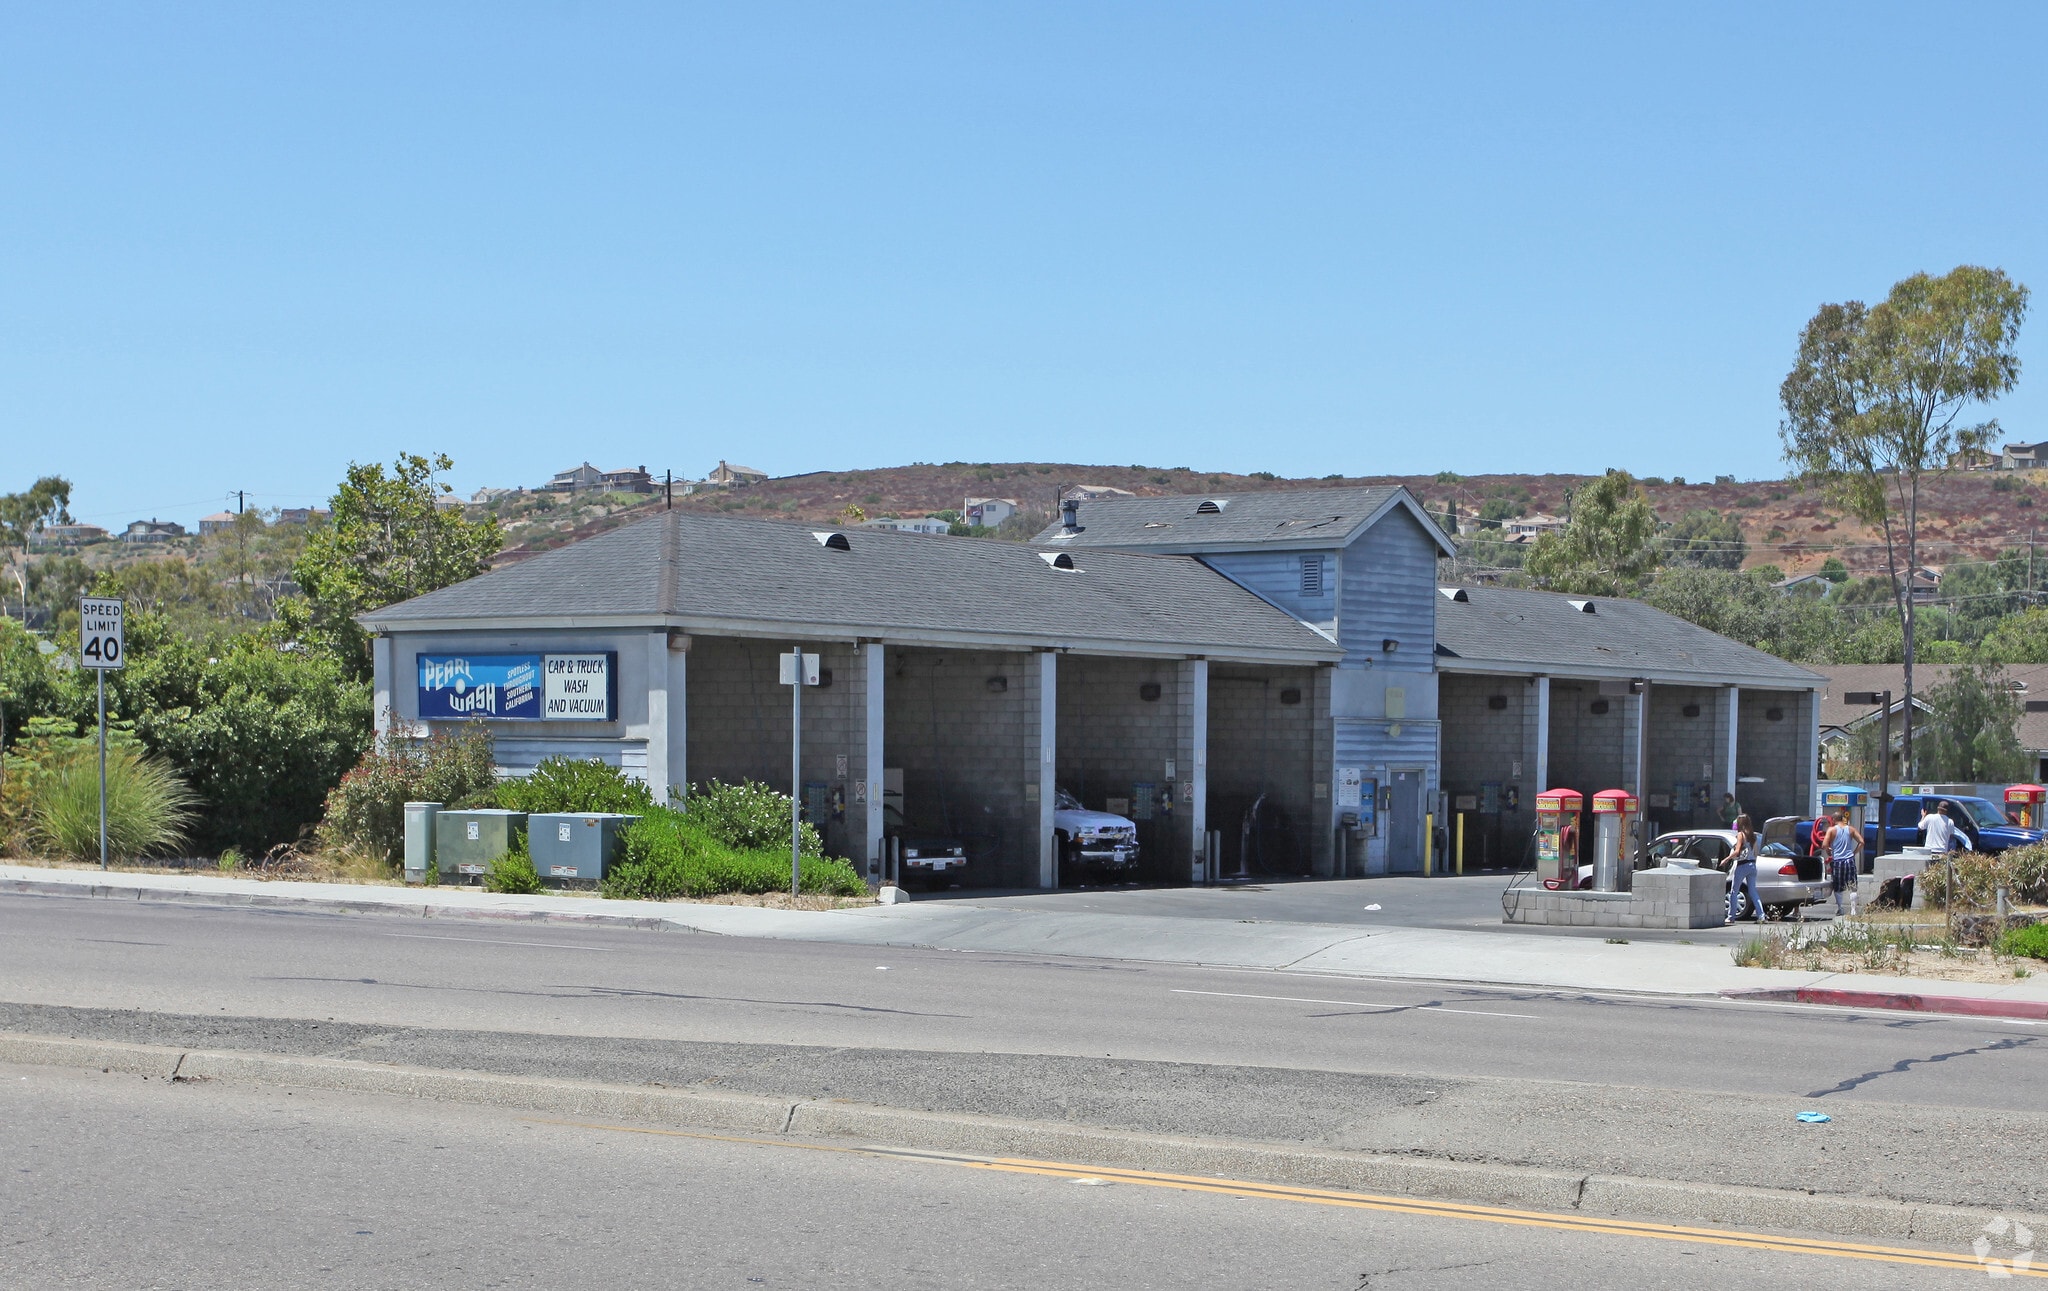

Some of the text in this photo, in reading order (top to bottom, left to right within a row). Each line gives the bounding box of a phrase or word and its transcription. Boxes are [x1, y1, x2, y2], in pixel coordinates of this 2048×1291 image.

[83, 604, 120, 616] SPEED
[87, 620, 117, 631] LIMIT
[84, 636, 119, 661] 40
[425, 658, 474, 692] PEARL
[507, 661, 531, 680] SPOTLESS
[548, 660, 604, 674] CAR & TRUCK
[506, 681, 532, 700] SOUTHERN
[564, 679, 589, 693] WASH
[449, 682, 496, 715] WASH
[505, 691, 534, 711] CALIFORNIA
[547, 699, 604, 713] AND VACUUM
